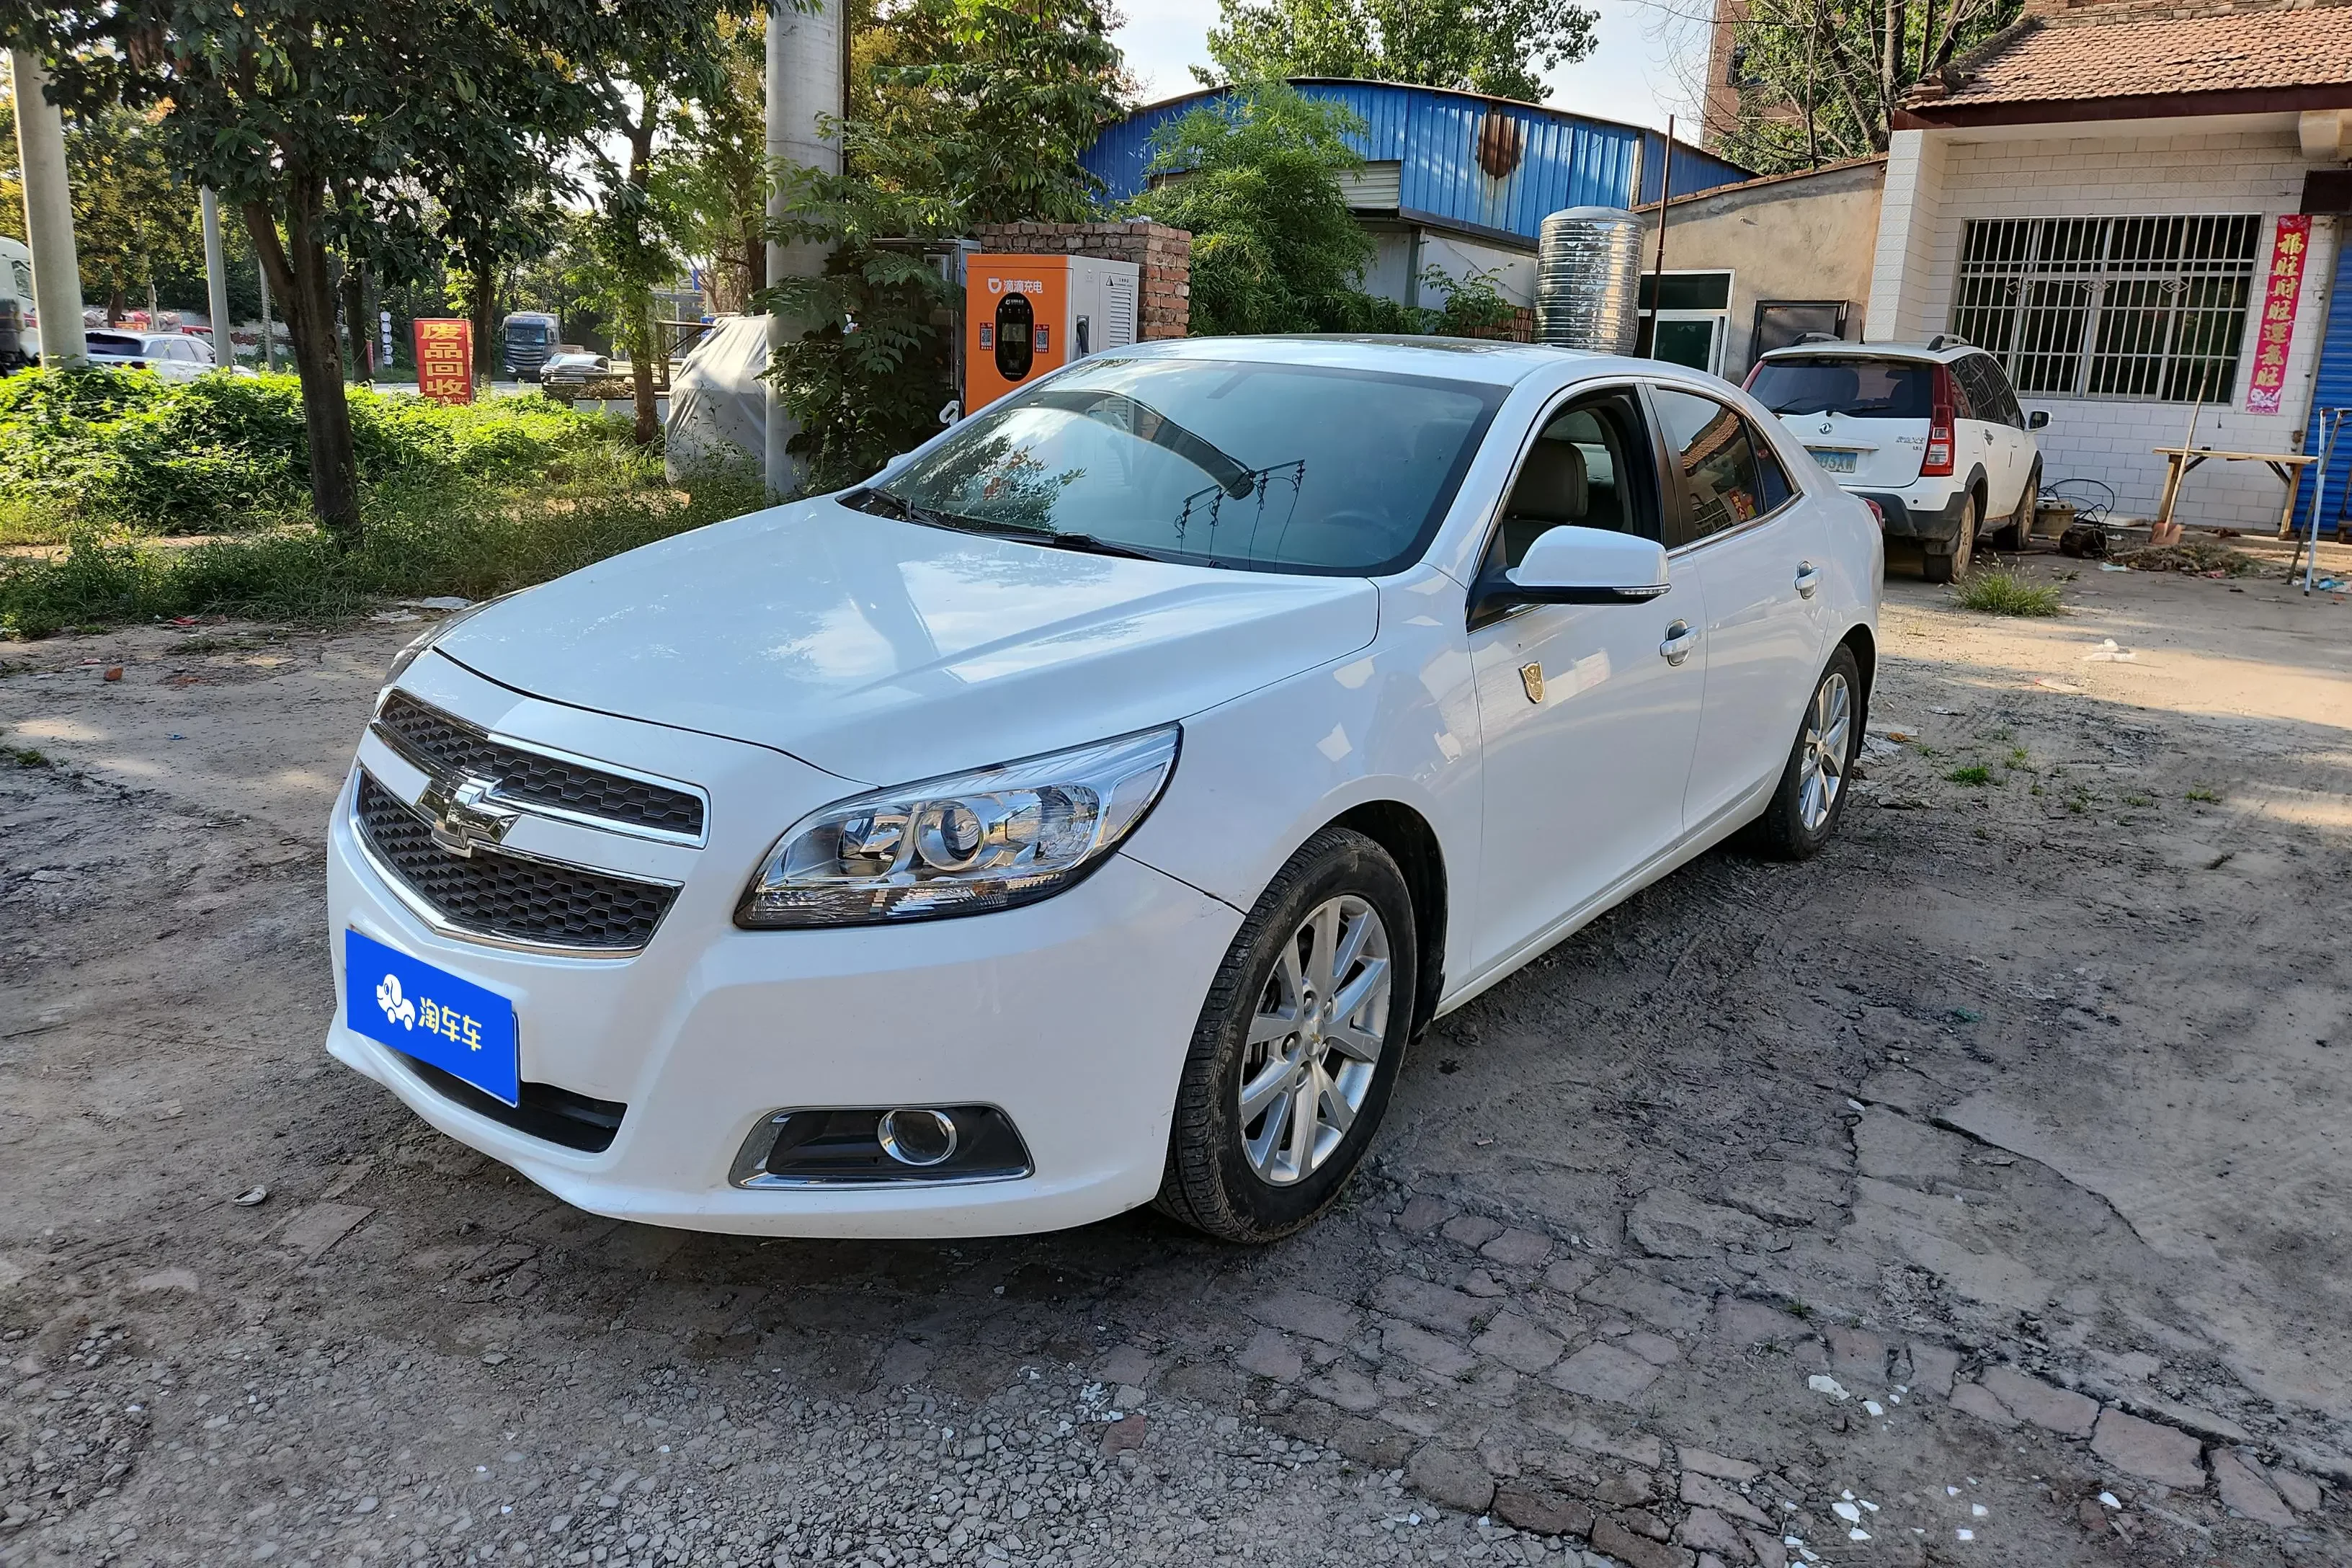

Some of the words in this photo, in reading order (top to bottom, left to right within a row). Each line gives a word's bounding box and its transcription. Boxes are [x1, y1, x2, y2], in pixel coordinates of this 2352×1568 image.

[1003, 279, 1043, 294] 滴滴充电
[420, 323, 467, 396] 废品回收
